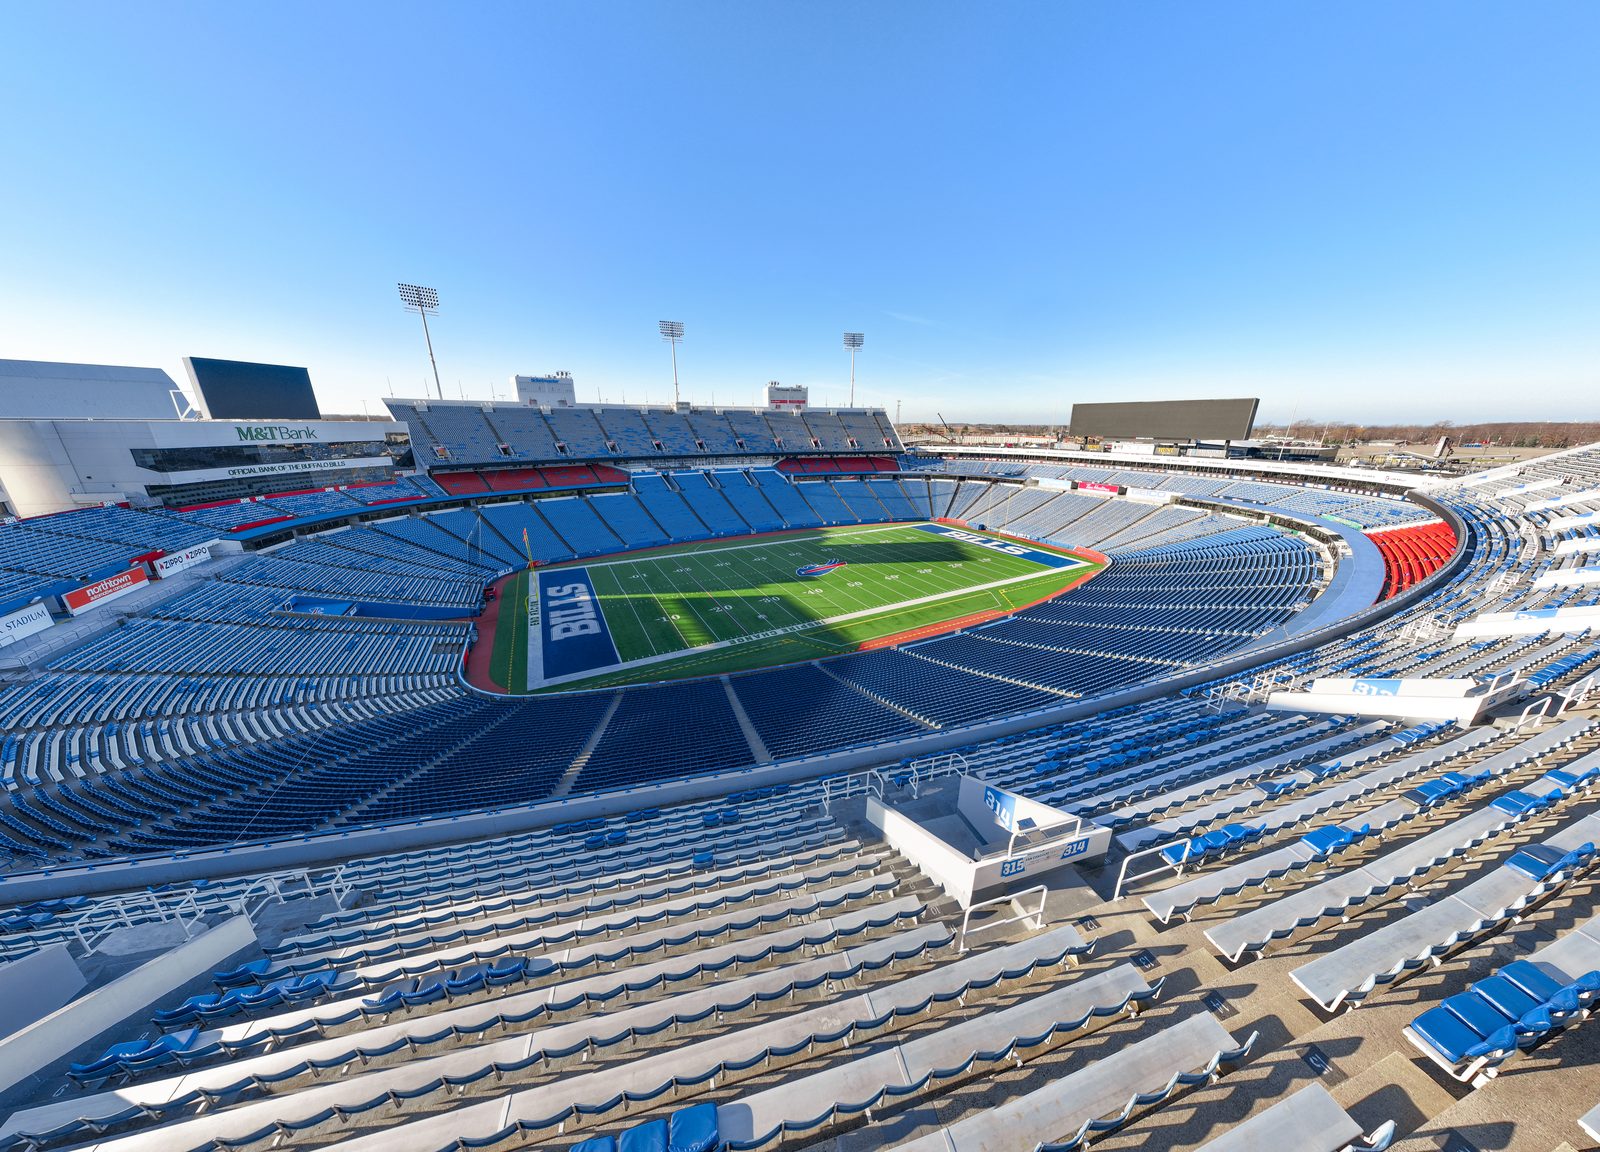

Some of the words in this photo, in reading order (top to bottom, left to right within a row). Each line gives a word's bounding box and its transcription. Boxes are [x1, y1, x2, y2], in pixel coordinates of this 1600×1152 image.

[235, 426, 278, 441] M&T
[278, 426, 318, 440] Bank
[228, 466, 257, 476] OFFICIAL
[289, 463, 301, 471] THE
[300, 462, 329, 470] BUFFALO
[329, 460, 346, 468] BILLS
[1131, 488, 1166, 498] GEICO
[939, 530, 1033, 556] BILLS
[164, 555, 184, 569] ZIPPO
[189, 546, 208, 560] ZIPPO
[86, 573, 132, 598] northtown
[547, 583, 602, 642] BILLS
[715, 604, 734, 614] 20
[5, 609, 47, 632] STADIUM
[661, 613, 682, 623] 10
[780, 619, 826, 634] INSPIRE
[727, 630, 778, 645] CHANGE
[985, 790, 1012, 829] 314
[1063, 841, 1086, 857] 314
[1002, 859, 1025, 876] 315
[1084, 919, 1098, 931] 12
[1139, 955, 1155, 969] 13
[1210, 999, 1230, 1014] 14
[1309, 1054, 1335, 1075] 15
